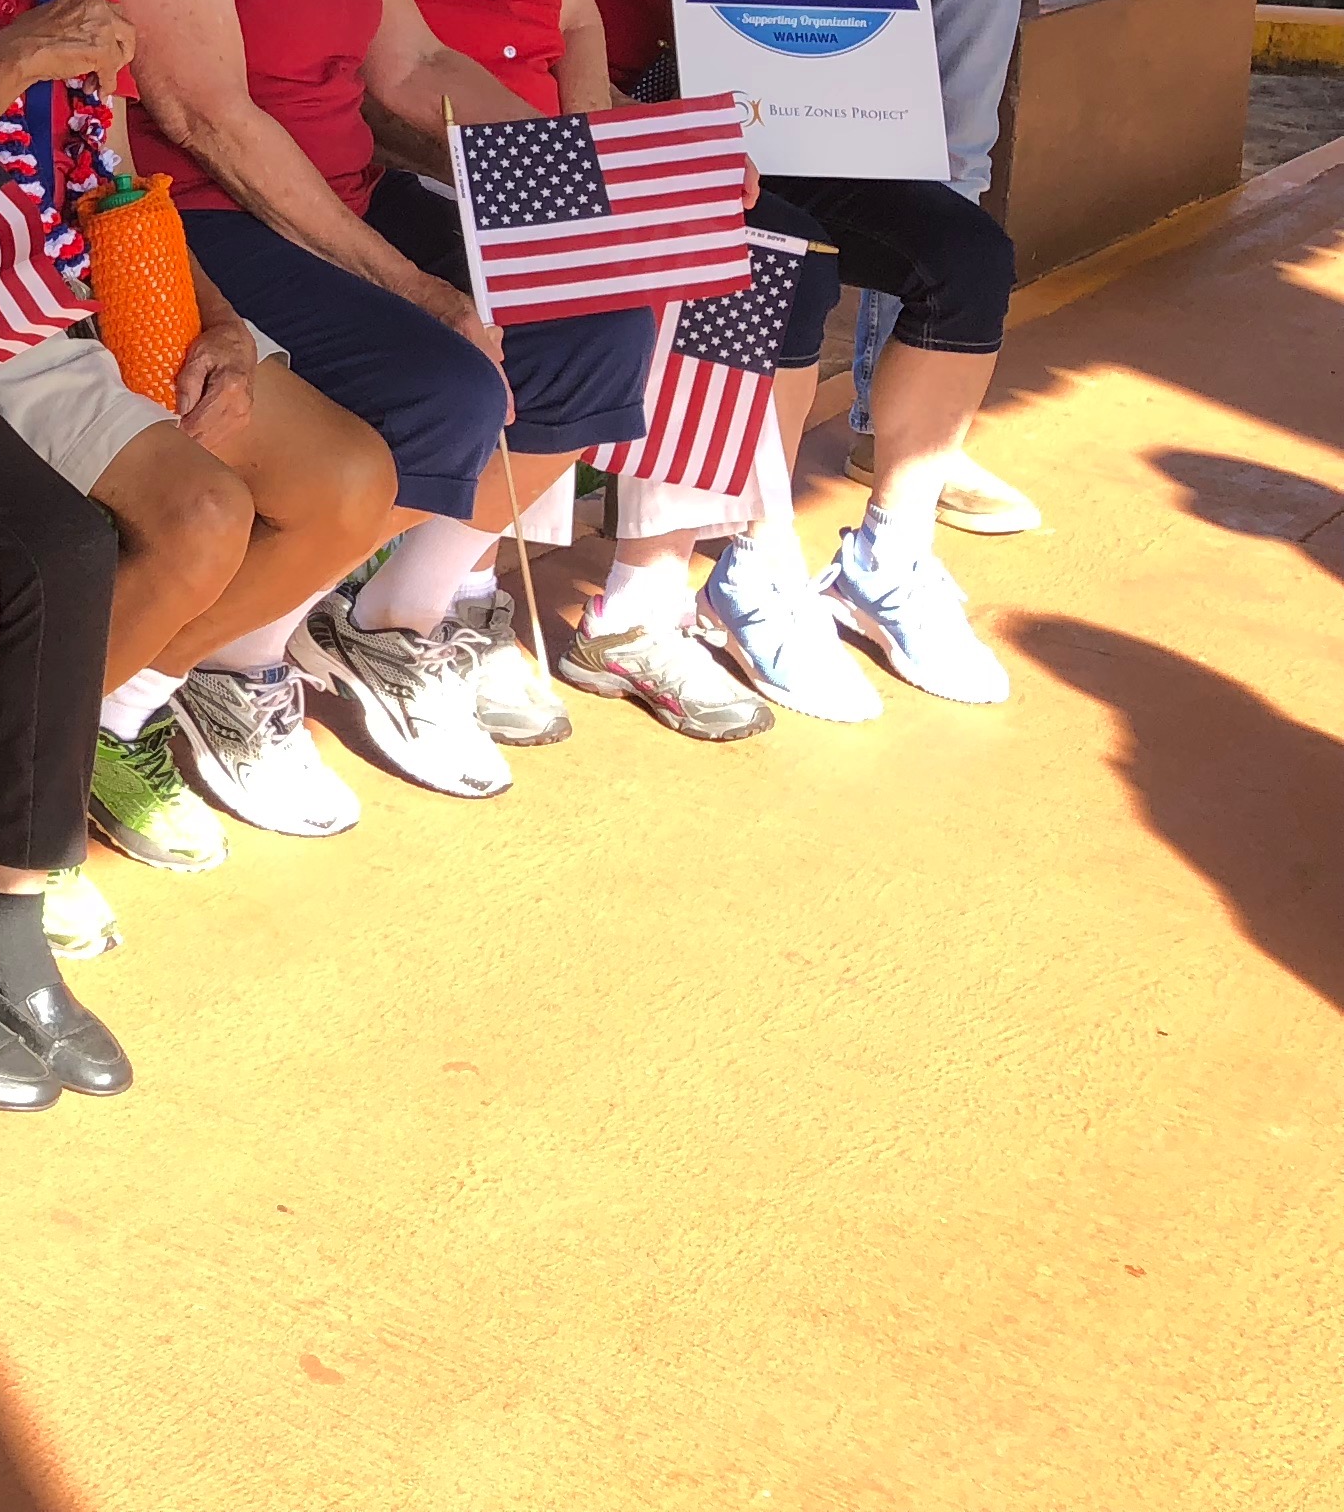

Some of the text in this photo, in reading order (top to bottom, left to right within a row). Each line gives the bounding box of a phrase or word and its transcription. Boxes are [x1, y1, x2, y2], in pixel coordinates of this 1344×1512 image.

[740, 13, 868, 29] Supporting Organization
[773, 31, 839, 44] WAHIAWA
